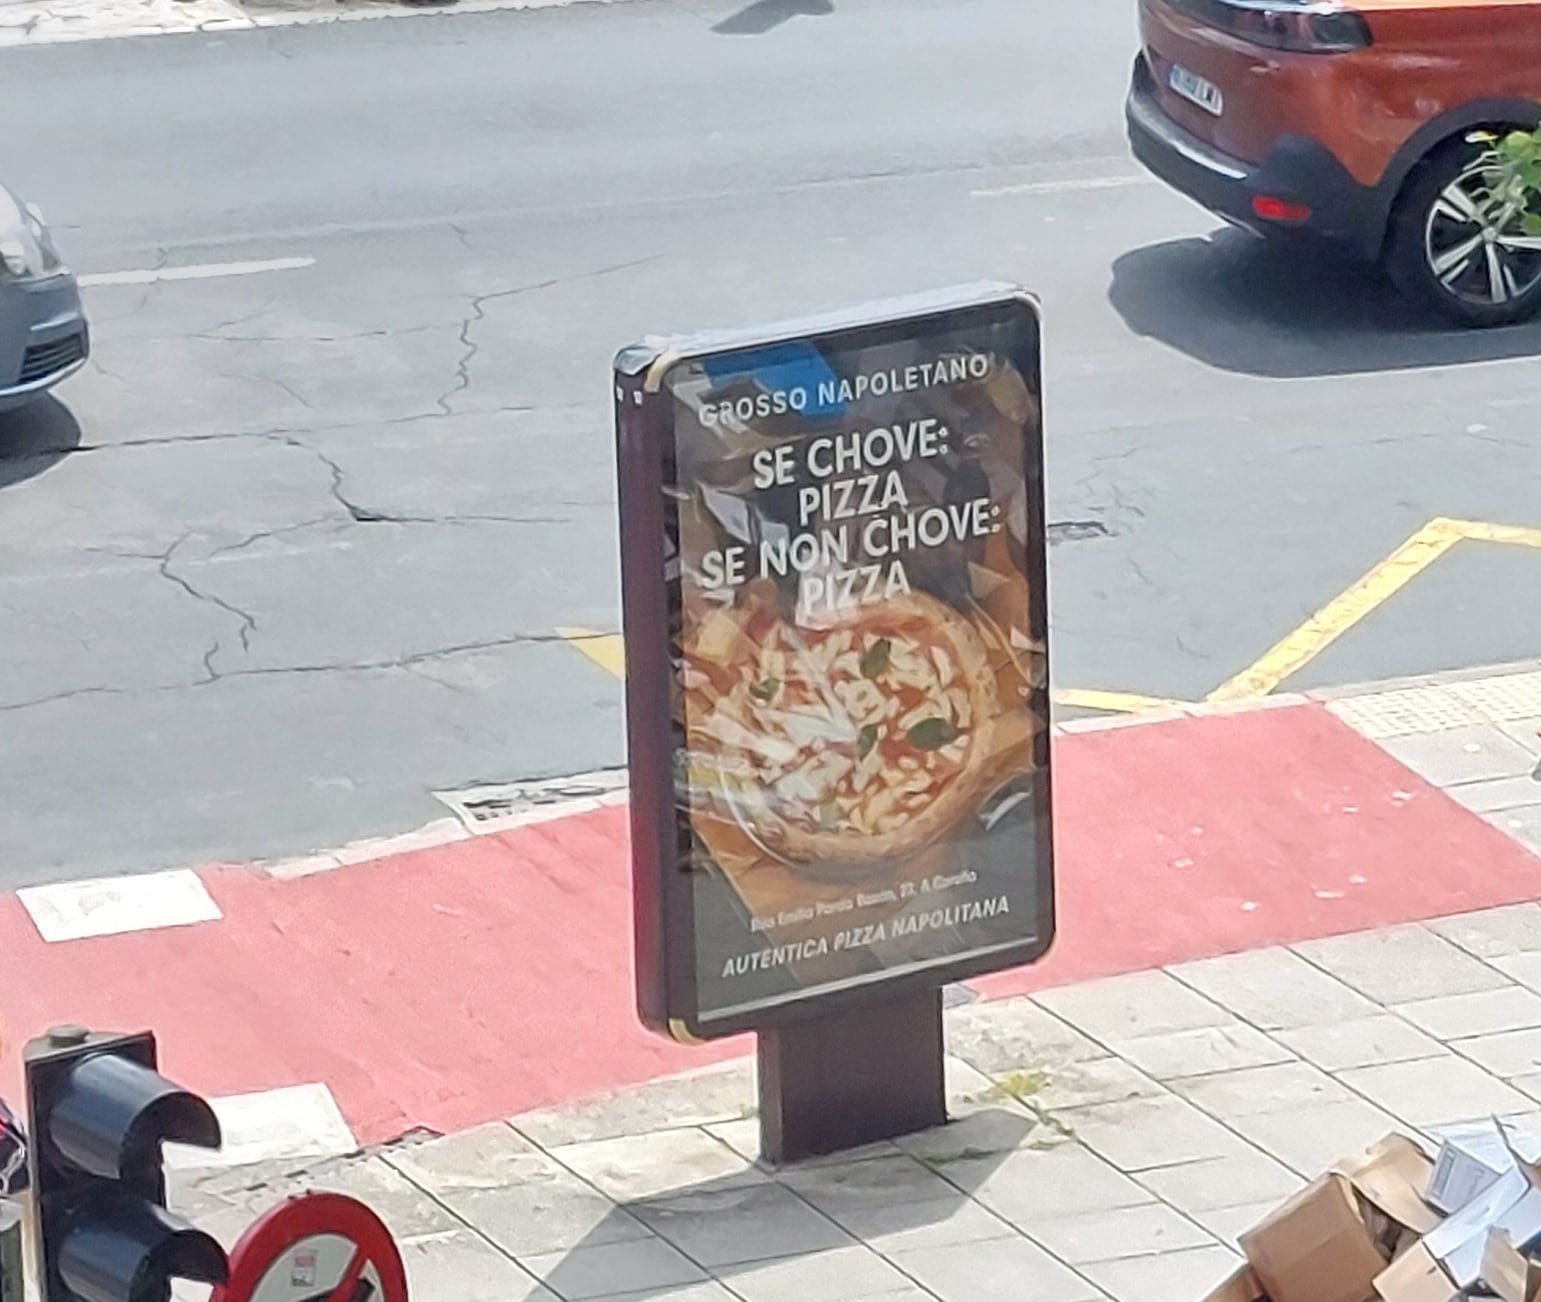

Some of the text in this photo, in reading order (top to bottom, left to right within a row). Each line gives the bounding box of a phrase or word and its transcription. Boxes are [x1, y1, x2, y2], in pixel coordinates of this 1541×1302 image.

[699, 354, 988, 427] GROSSO NAPOLETANO
[753, 419, 949, 489] SE CHOVE:
[800, 469, 908, 526] PIZZA
[701, 498, 1000, 590] SE NON CHOVE:
[803, 559, 911, 615] PIZZA
[721, 895, 1010, 978] AUTENTICA PIZZA NAPOLITANA
